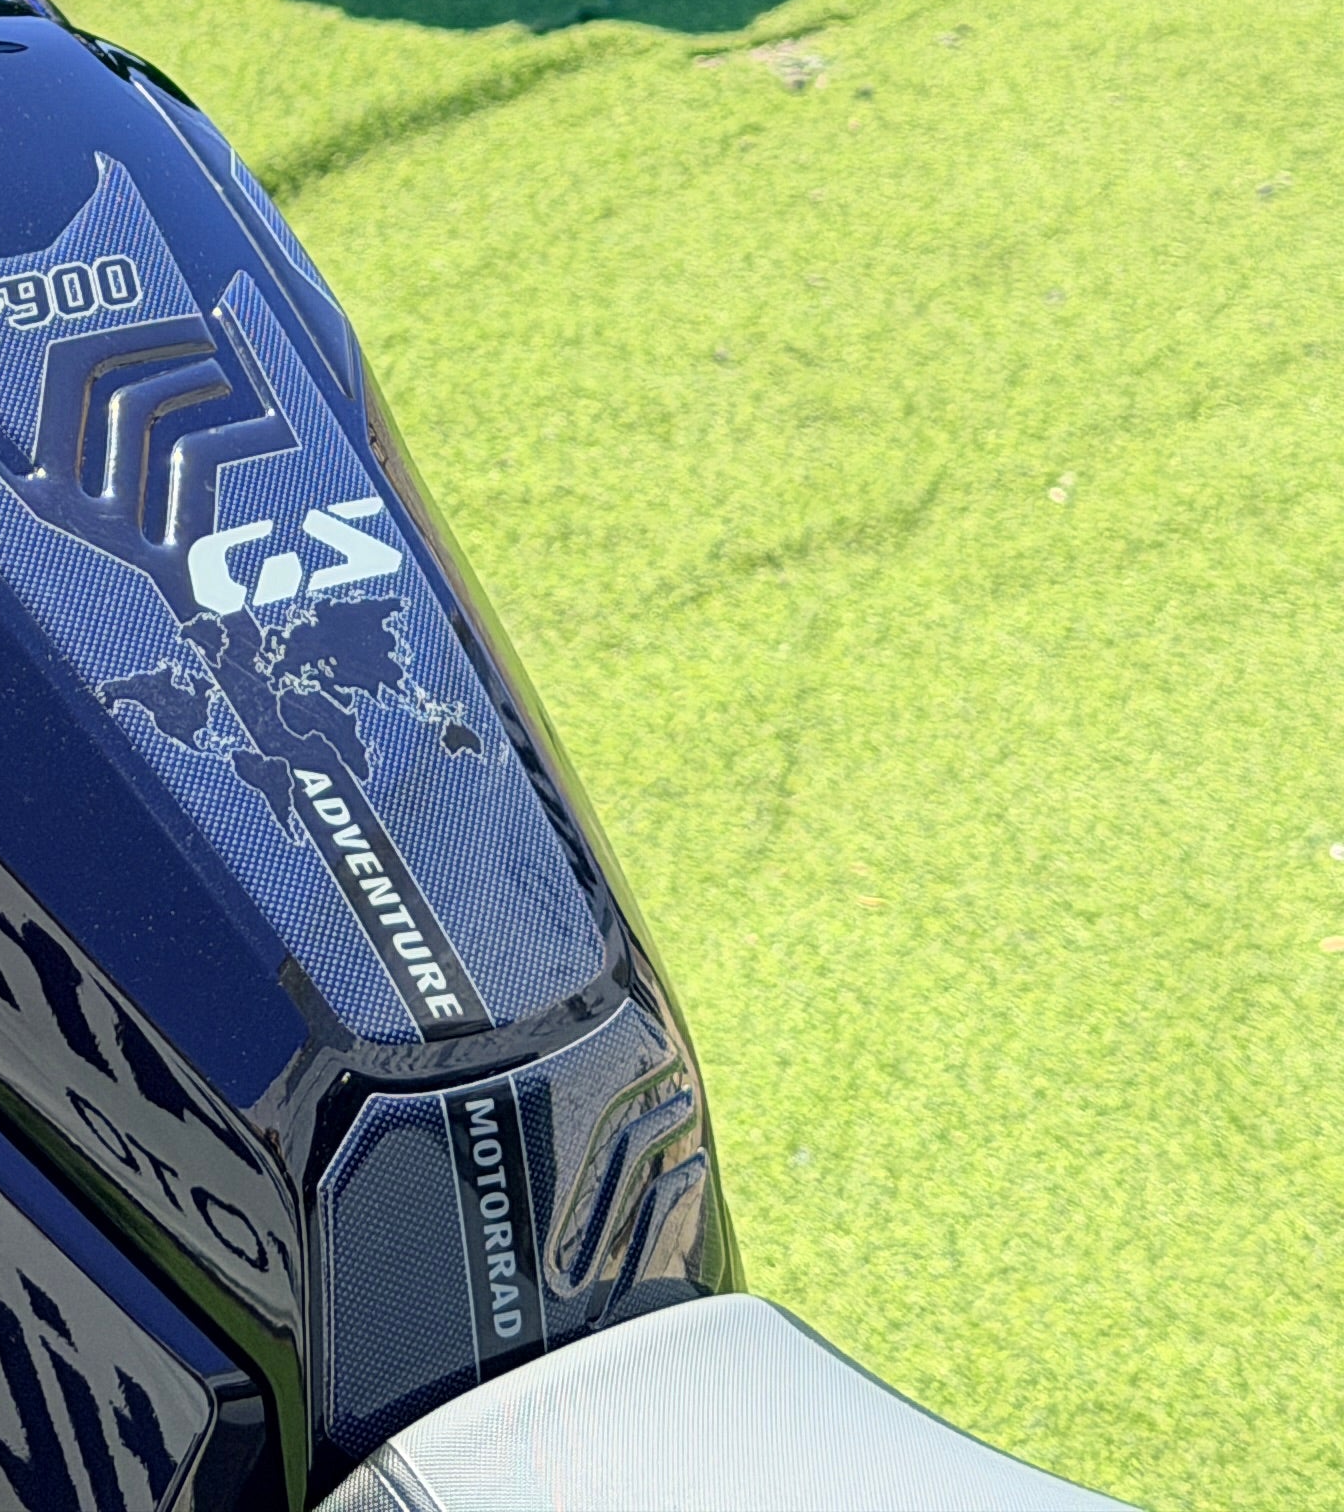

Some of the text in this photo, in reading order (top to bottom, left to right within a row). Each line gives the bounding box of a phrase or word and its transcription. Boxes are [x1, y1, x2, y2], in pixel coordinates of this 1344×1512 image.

[188, 496, 403, 615] GS
[293, 767, 463, 1021] ADVENTURE
[464, 1096, 523, 1341] MOTORRAD
